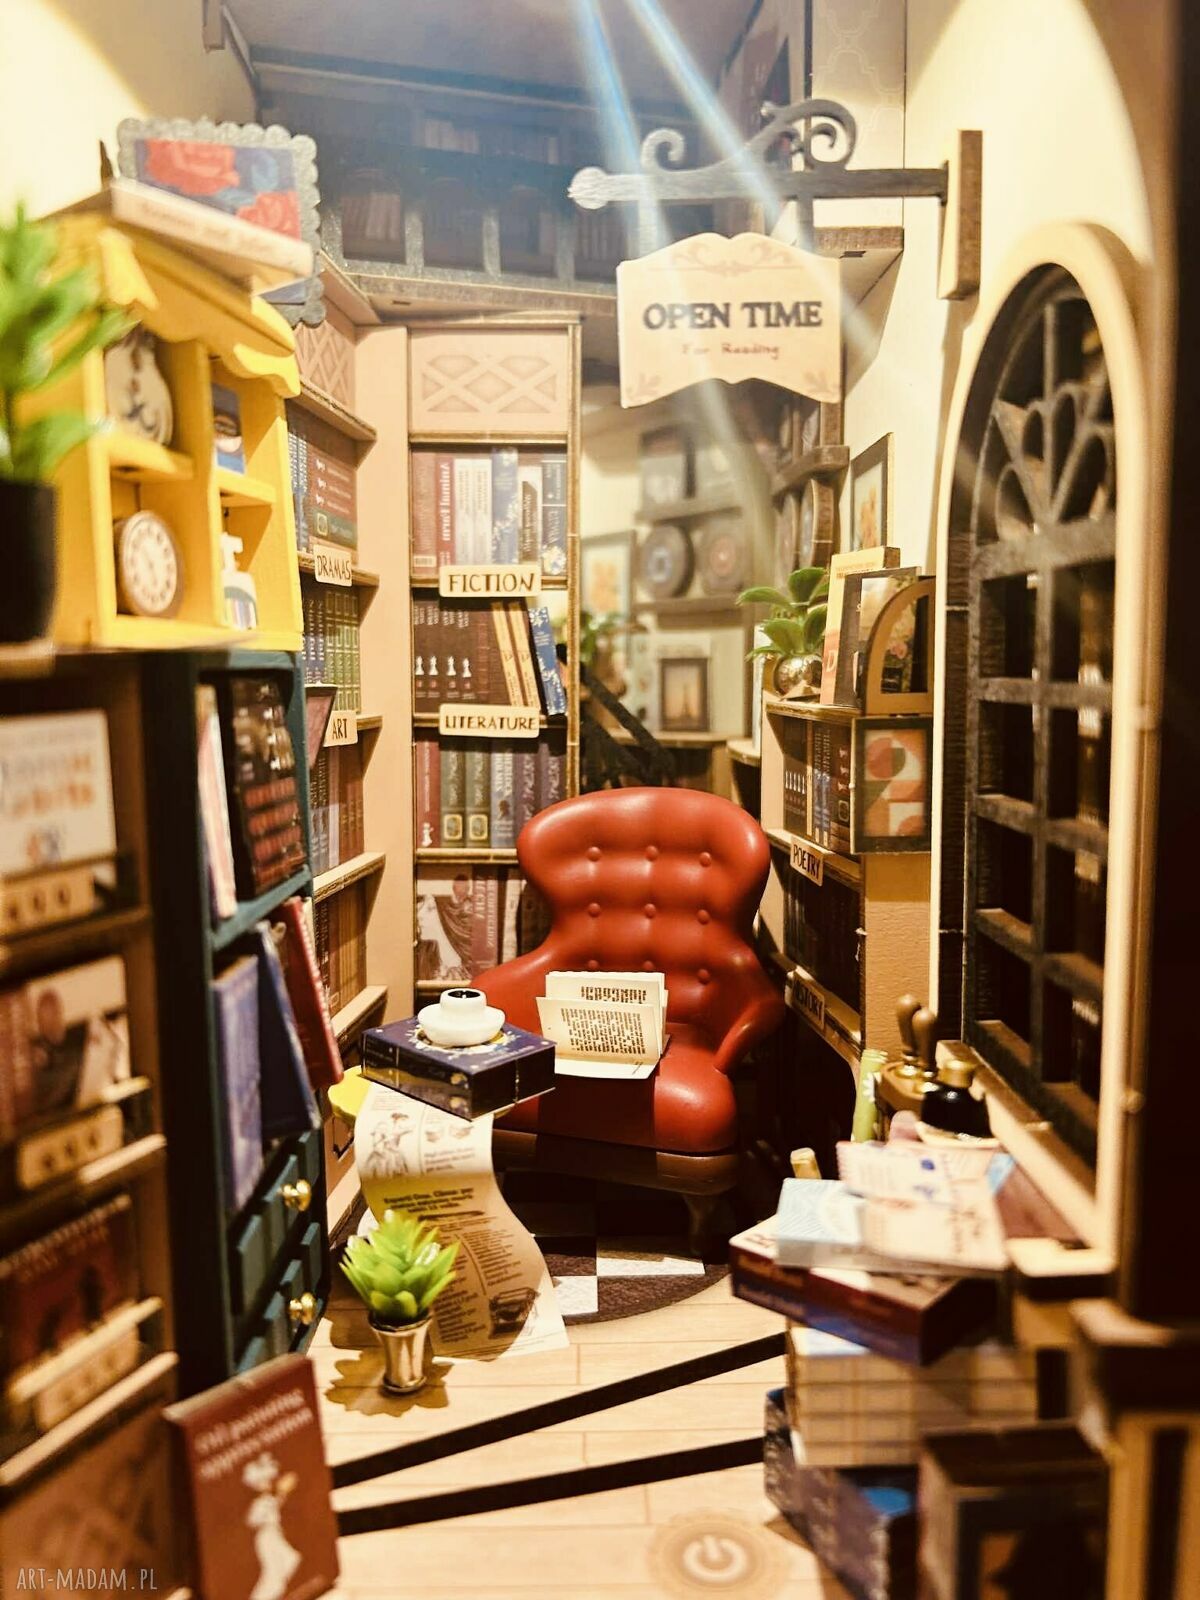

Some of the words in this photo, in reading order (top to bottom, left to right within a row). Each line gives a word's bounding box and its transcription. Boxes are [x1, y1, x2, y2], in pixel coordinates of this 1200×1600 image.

[643, 302, 731, 330] OPEN
[740, 300, 822, 328] TIME
[721, 342, 780, 360] Reading
[316, 555, 351, 581] DRAMAS
[448, 573, 535, 593] FICTION
[331, 718, 348, 740] ART
[445, 715, 538, 731] LITERATURE
[793, 844, 820, 879] POETRY
